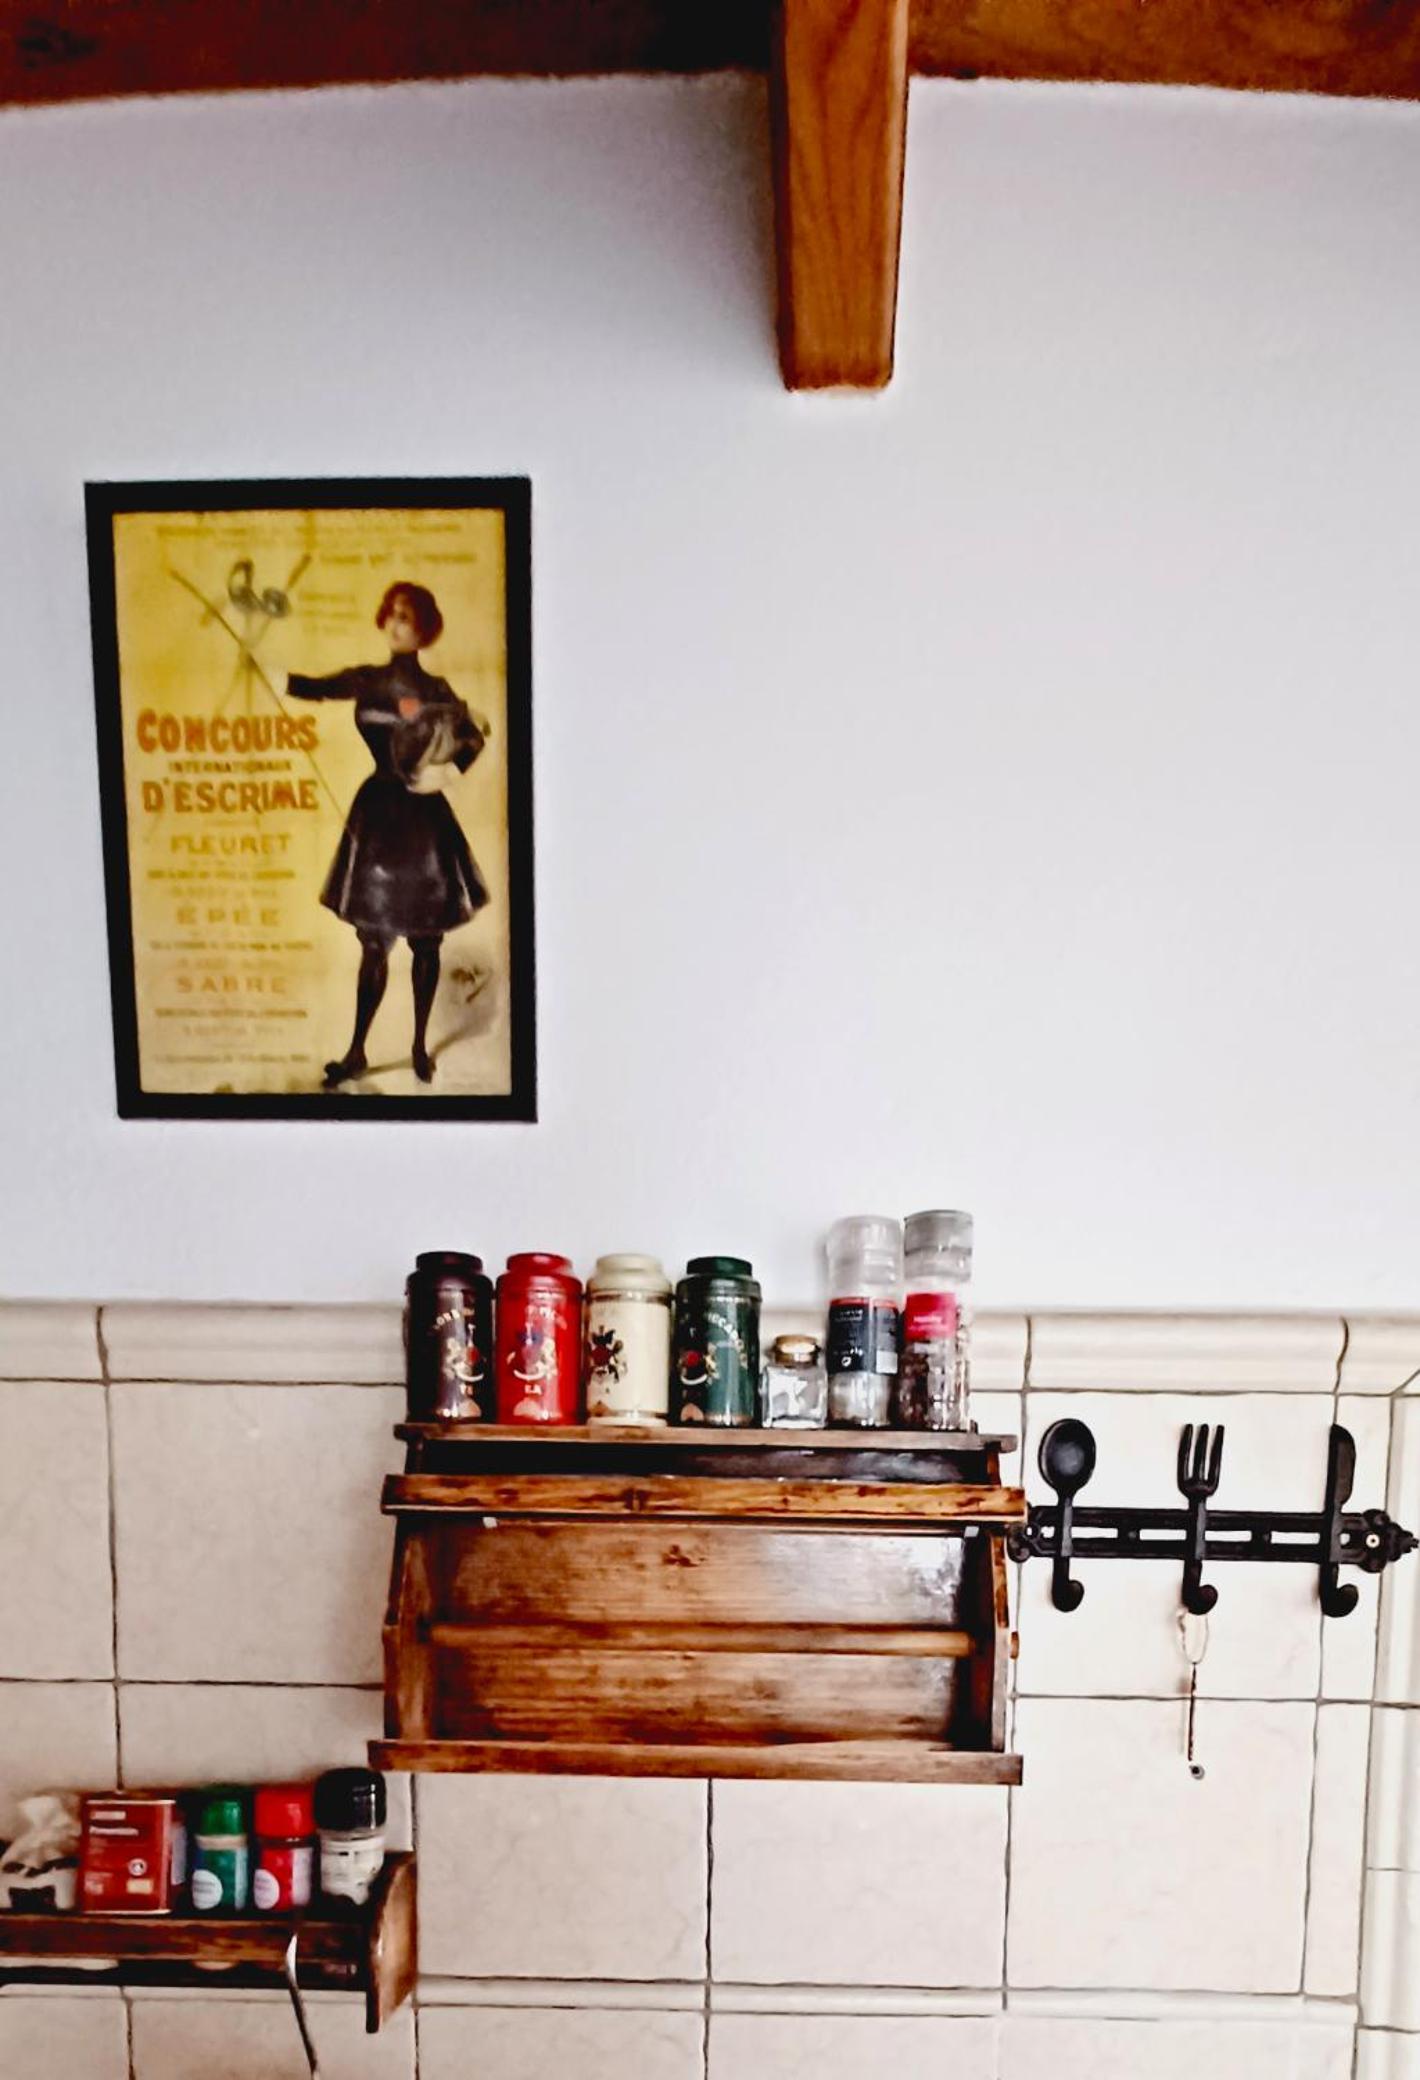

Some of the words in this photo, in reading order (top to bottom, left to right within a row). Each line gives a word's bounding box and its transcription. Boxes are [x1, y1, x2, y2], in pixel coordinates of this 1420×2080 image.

[136, 708, 320, 755] CONCOURS
[142, 777, 320, 815] D'ESCRIME
[170, 832, 291, 857] FLEURET
[177, 976, 288, 994] SABRE
